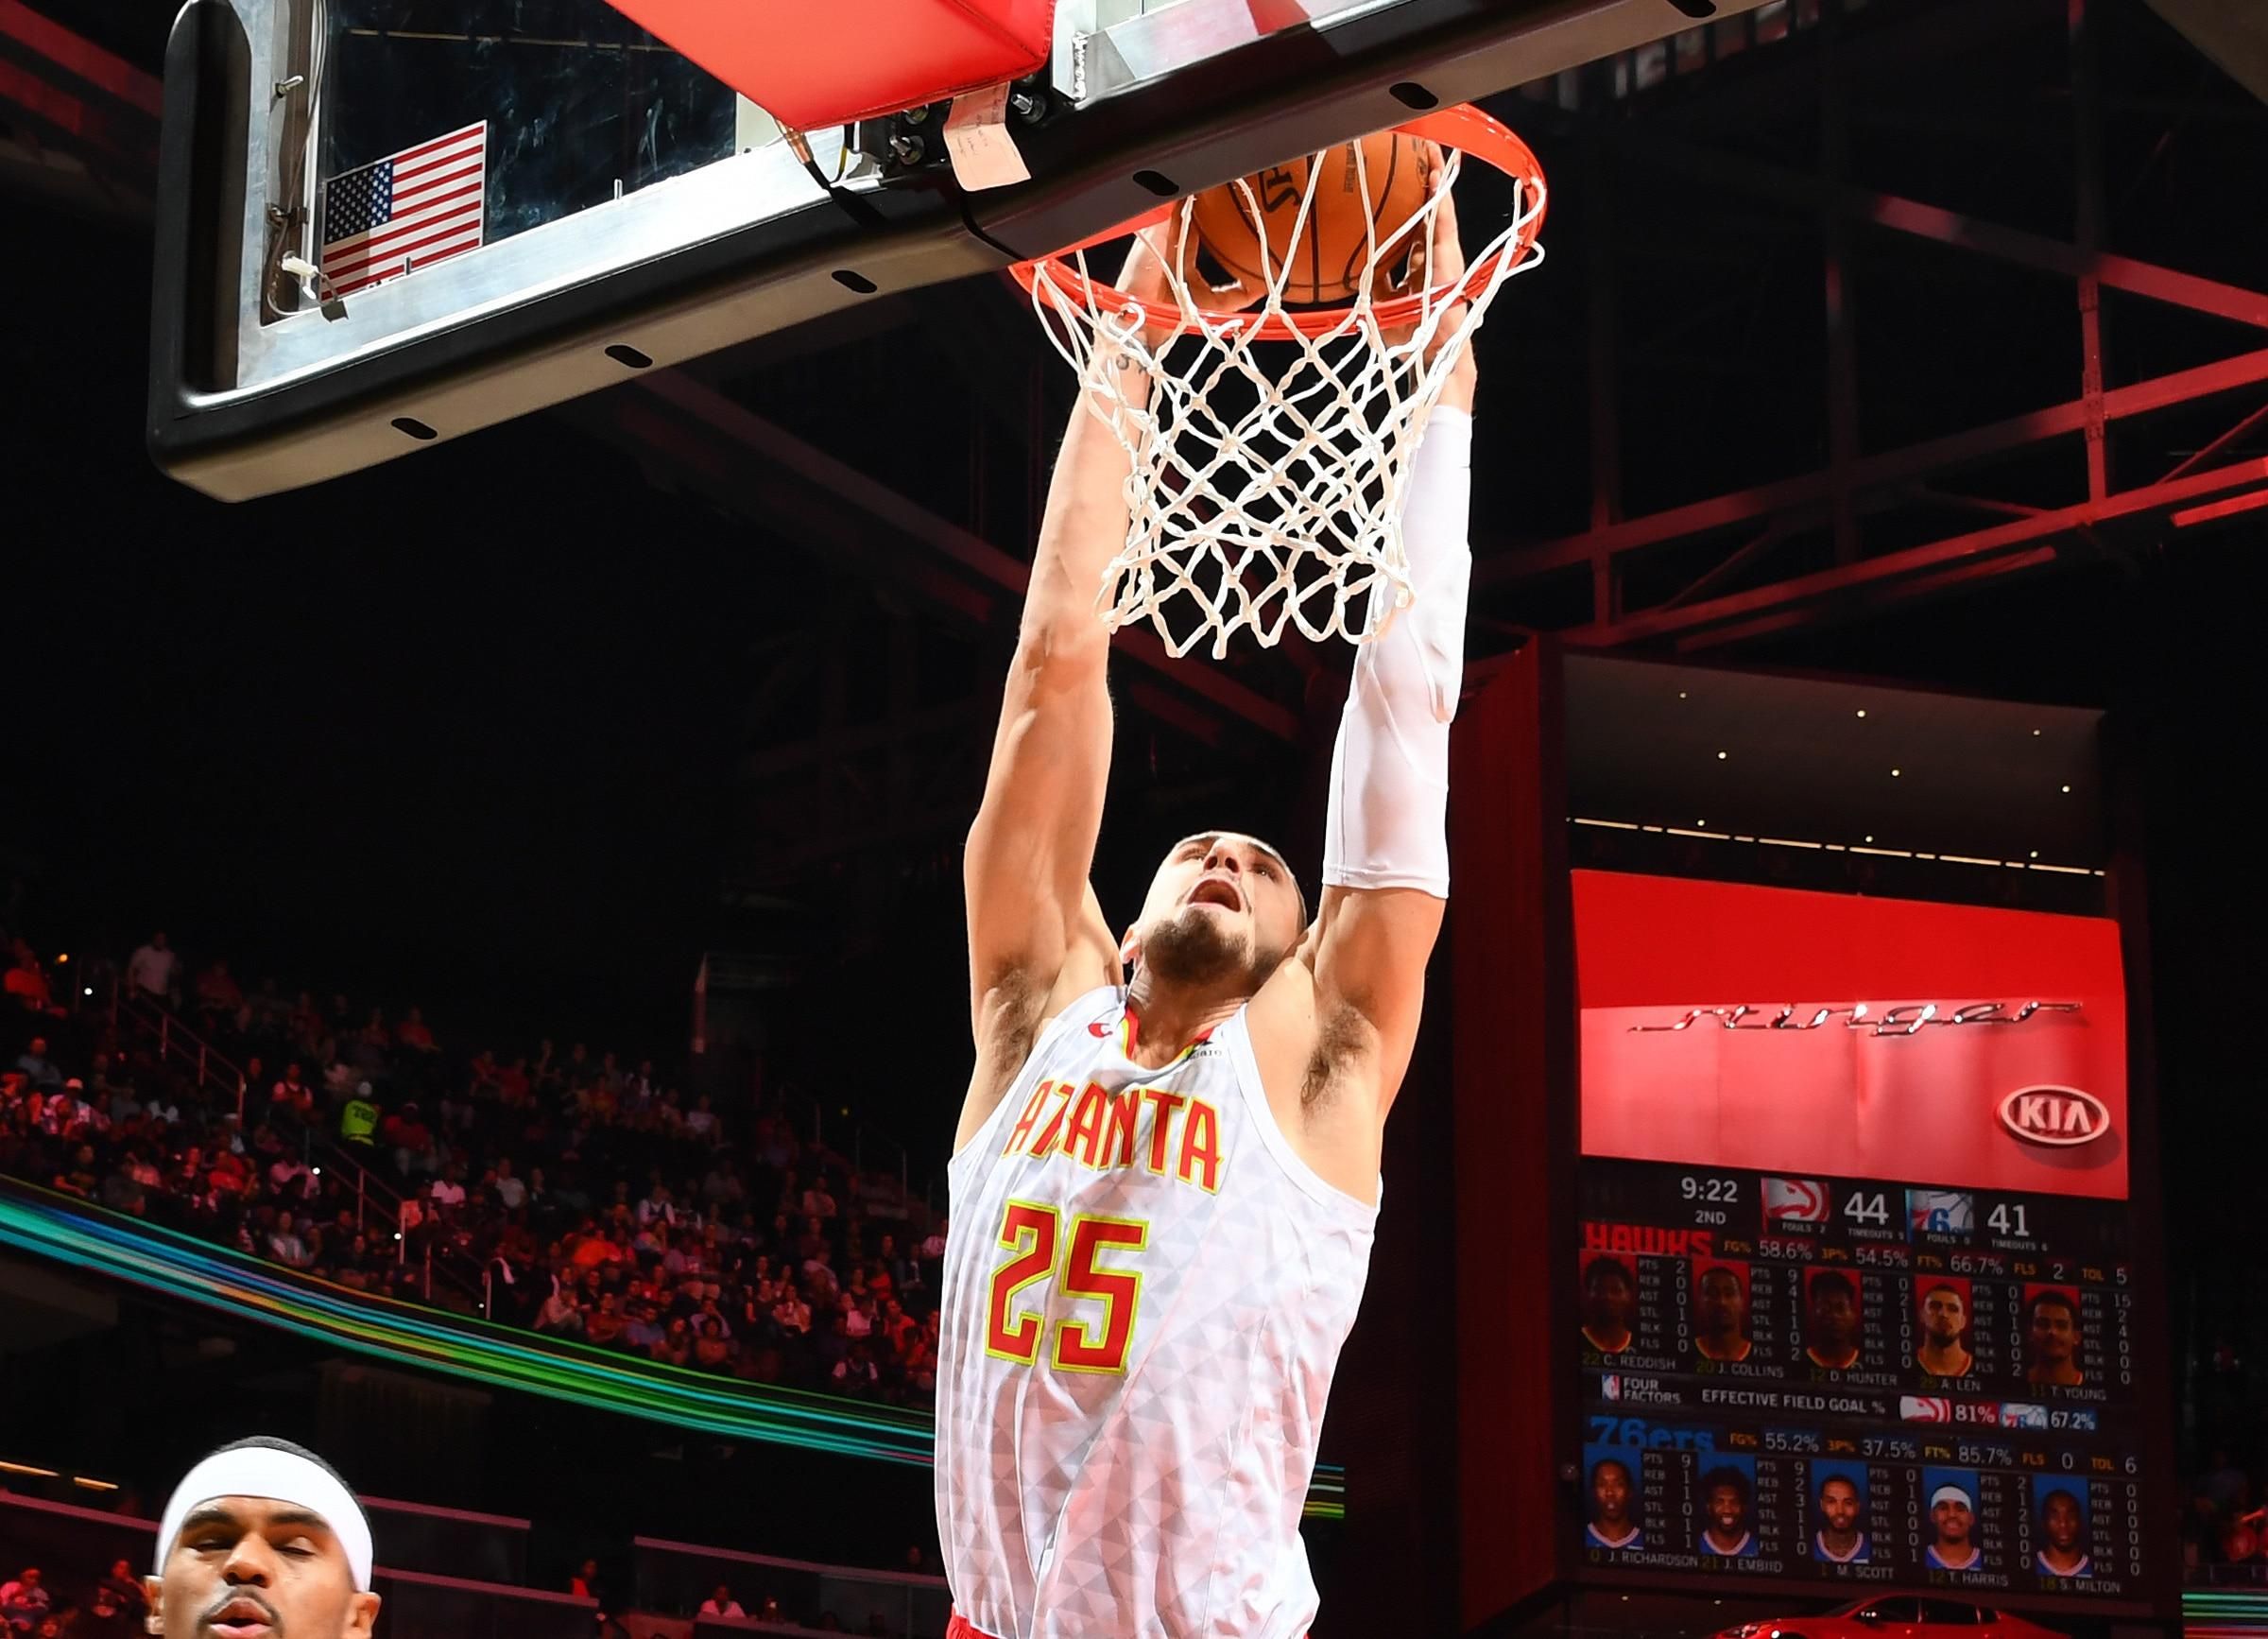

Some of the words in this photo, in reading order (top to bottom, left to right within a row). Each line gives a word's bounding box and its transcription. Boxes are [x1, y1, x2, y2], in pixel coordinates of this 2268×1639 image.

[1628, 1002, 2082, 1037] stinger
[2019, 1096, 2091, 1133] KIA
[1681, 1177, 1738, 1203] 9:22
[1844, 1191, 1889, 1225] 44
[1694, 1210, 1727, 1225] 2ND
[1987, 1203, 2030, 1237] 41
[1585, 1220, 1715, 1255] HAWKS
[1992, 1238, 2036, 1251] TIMEOUTS
[1760, 1240, 1813, 1261] 58.6%
[1855, 1248, 1909, 1268] 54.5%
[1950, 1255, 2003, 1275] 66.7%
[2053, 1263, 2064, 1280] 2
[2116, 1268, 2127, 1285] 5
[985, 1198, 1150, 1376] 25
[1620, 1355, 1675, 1370] REDDISH
[1731, 1363, 1784, 1379] COLLINS
[1846, 1372, 1898, 1386] HUNTER
[1624, 1377, 1658, 1390] FOUR
[1956, 1379, 1981, 1391] LEN
[1624, 1390, 1681, 1405] FACTORS
[1702, 1389, 1778, 1406] EFFECTIVE
[1783, 1394, 1826, 1410] FIELD
[1829, 1398, 1867, 1414] GOAL
[1871, 1400, 1885, 1415] %
[2064, 1387, 2106, 1401] YOUNG
[1955, 1405, 1995, 1423] 81%
[2051, 1411, 2096, 1430] 67.2%
[1589, 1415, 1714, 1452] 76ers
[1765, 1432, 1819, 1453] 55.2%
[1863, 1439, 1916, 1458] 37.5%
[1958, 1445, 2012, 1465] 85.7%
[2061, 1453, 2073, 1470] 0
[2125, 1457, 2137, 1474] 6
[1622, 1552, 1698, 1568] RICHARDSON
[1737, 1559, 1783, 1573] EMBIID
[1855, 1565, 1894, 1579] SCOTT
[1962, 1572, 2009, 1587] HARRIS
[2076, 1579, 2121, 1594] MILTON
